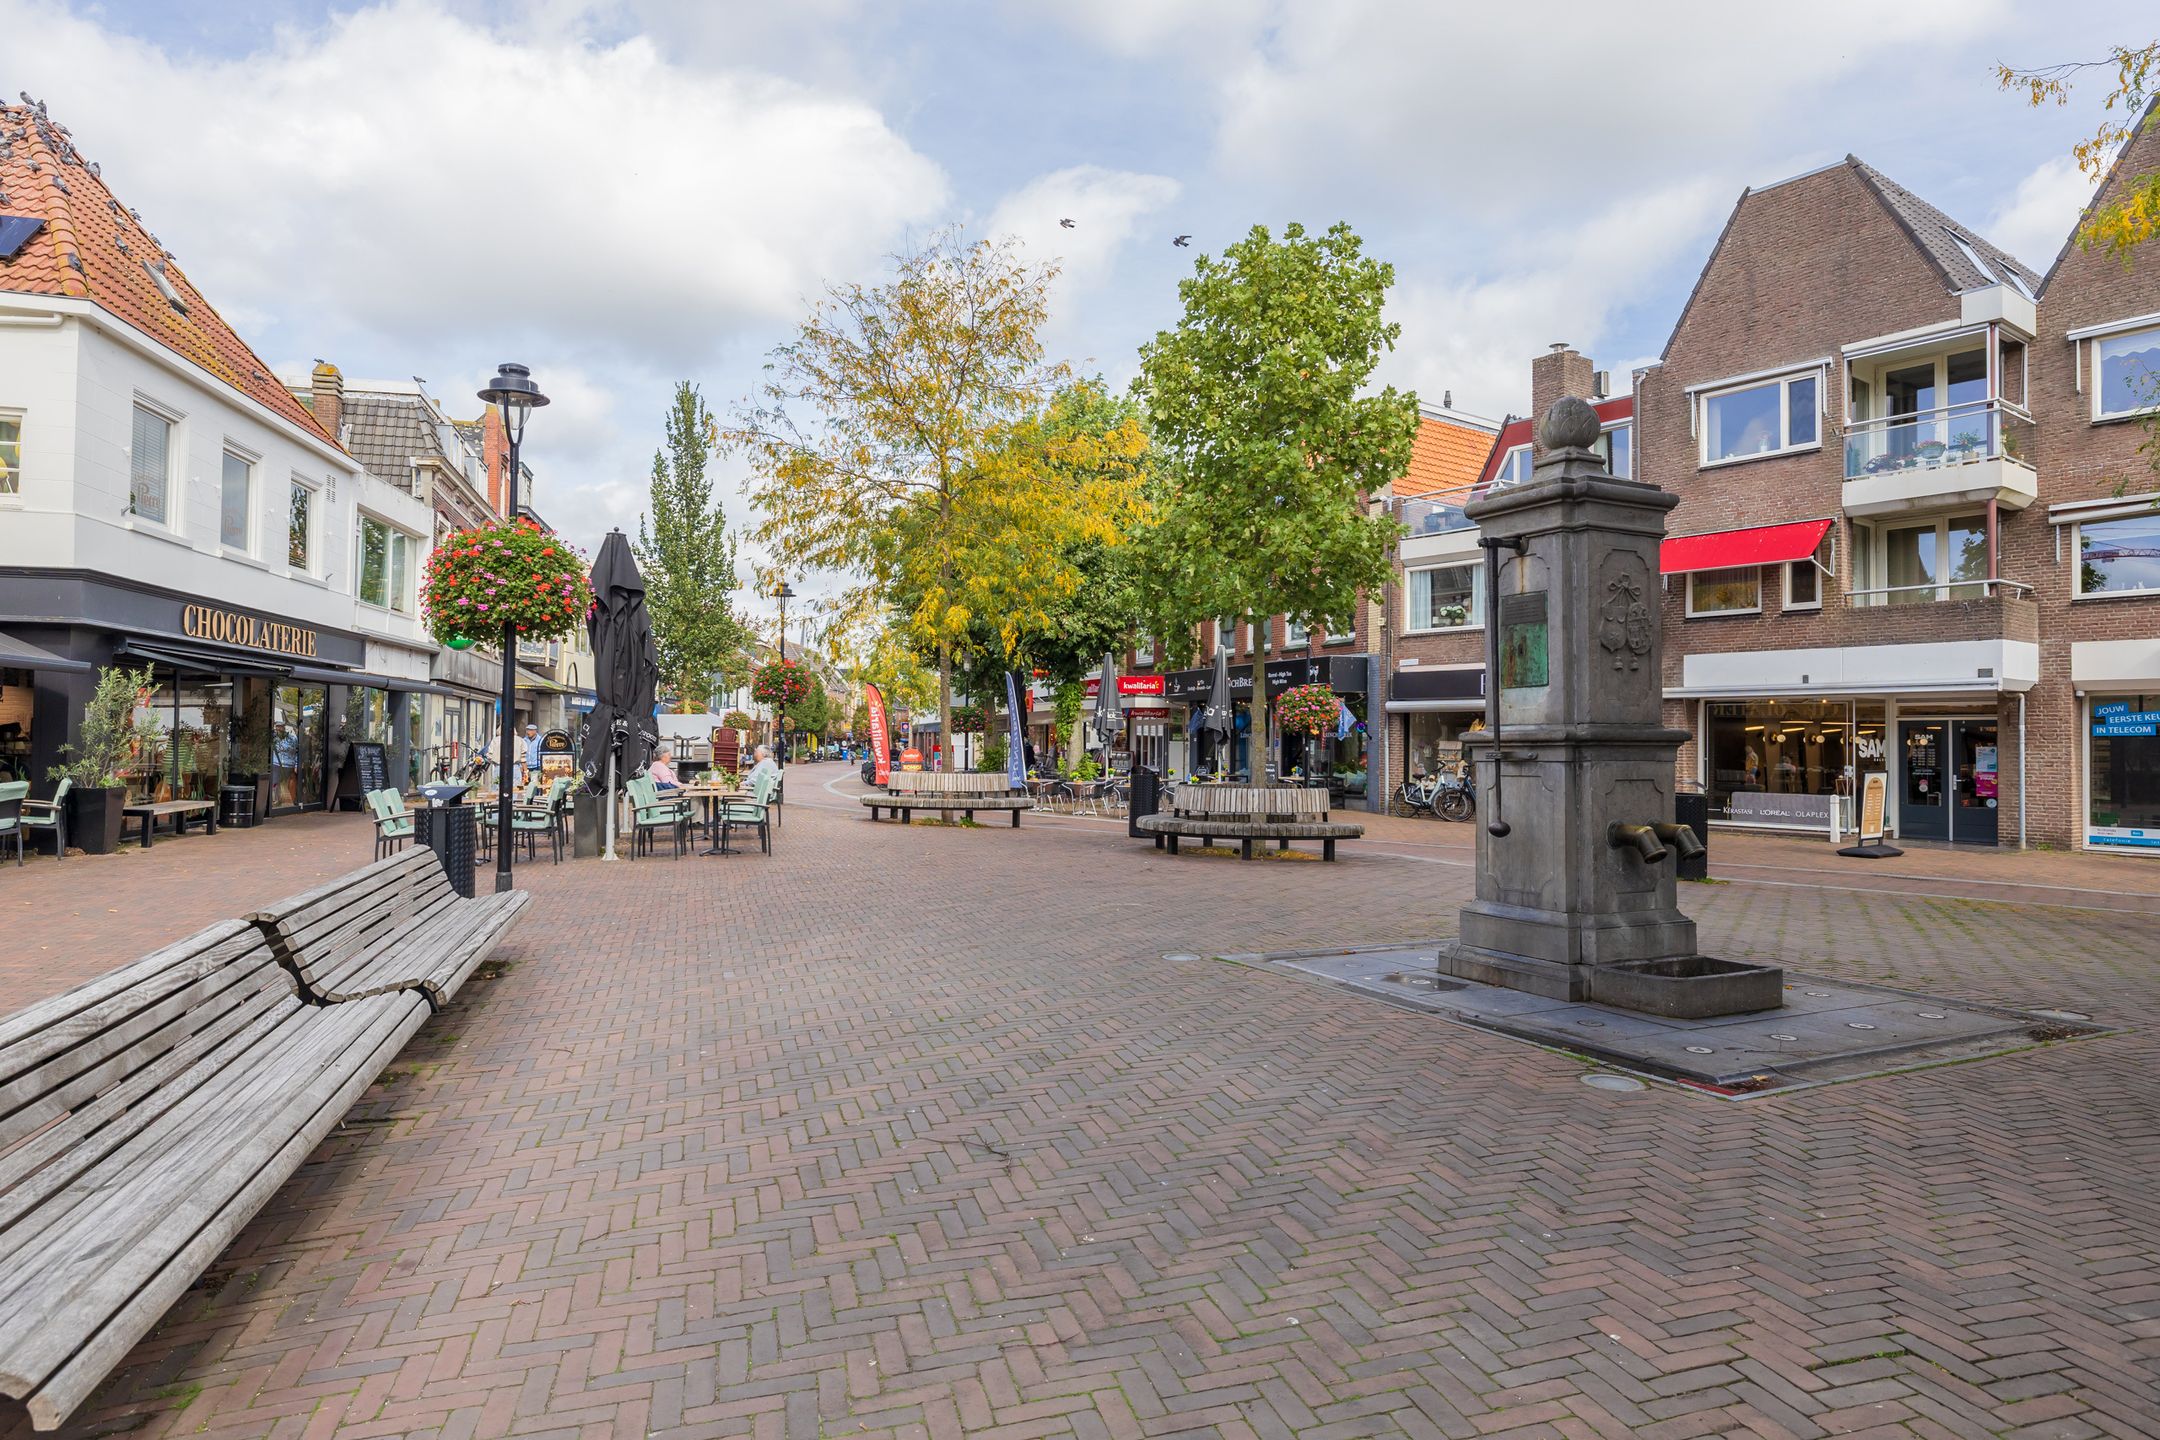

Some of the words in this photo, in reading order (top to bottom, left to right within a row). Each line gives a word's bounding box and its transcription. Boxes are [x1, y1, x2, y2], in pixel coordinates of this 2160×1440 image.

[183, 604, 317, 657] CHOCOLATERIE
[1123, 681, 1156, 689] kwalitaria
[2098, 704, 2125, 715] JOUW
[2109, 714, 2143, 724] EERSTE
[2108, 726, 2152, 734] TELECOM
[1859, 738, 1886, 758] SAM
[1795, 810, 1829, 819] OLAPLEX
